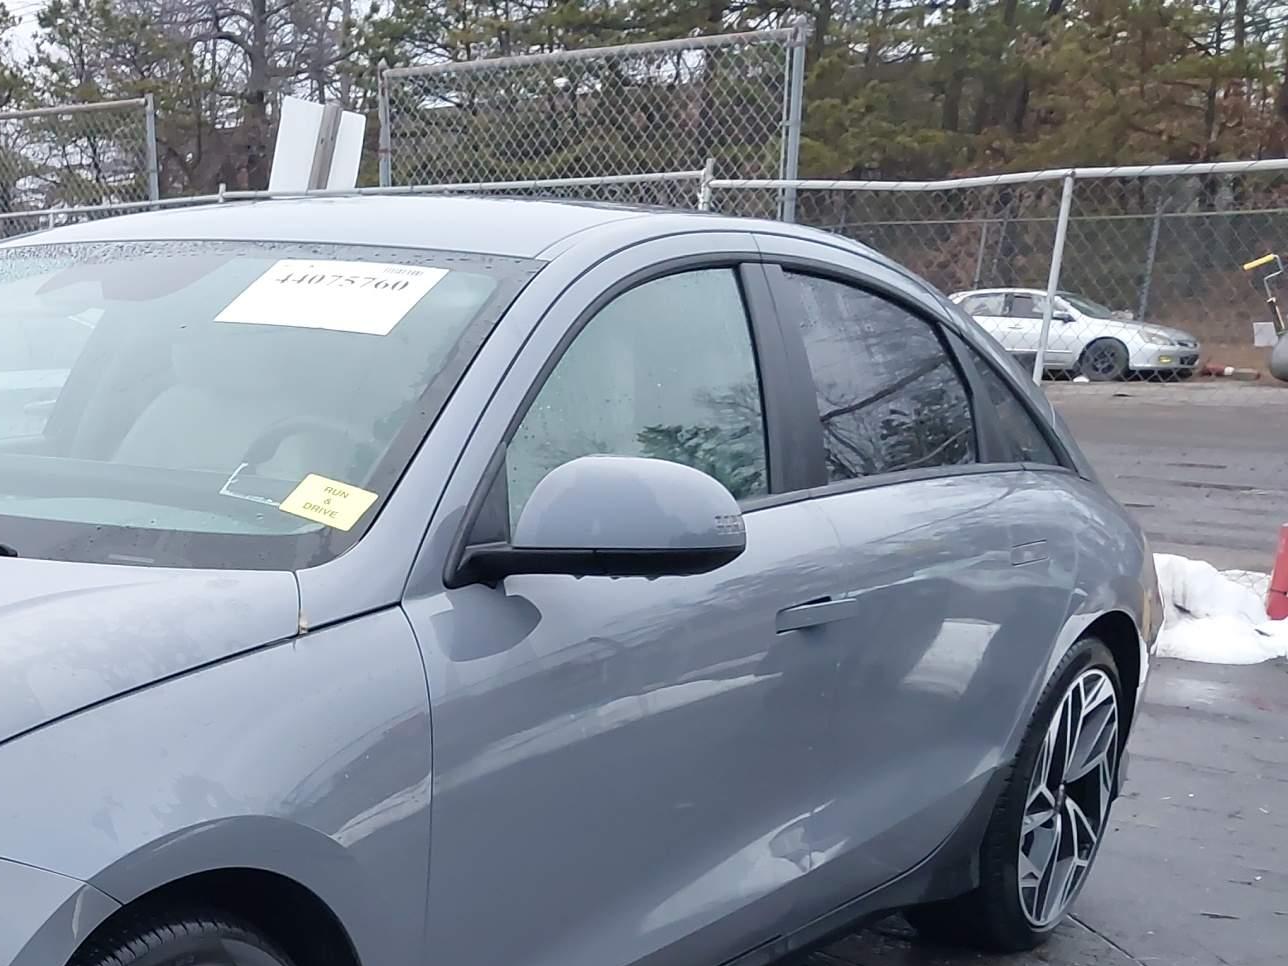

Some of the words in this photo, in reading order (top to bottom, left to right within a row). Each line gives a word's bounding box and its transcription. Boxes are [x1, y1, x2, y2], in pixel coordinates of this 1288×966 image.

[275, 272, 410, 291] 44075760
[323, 486, 349, 498] RUN
[302, 502, 339, 518] DRIVE
